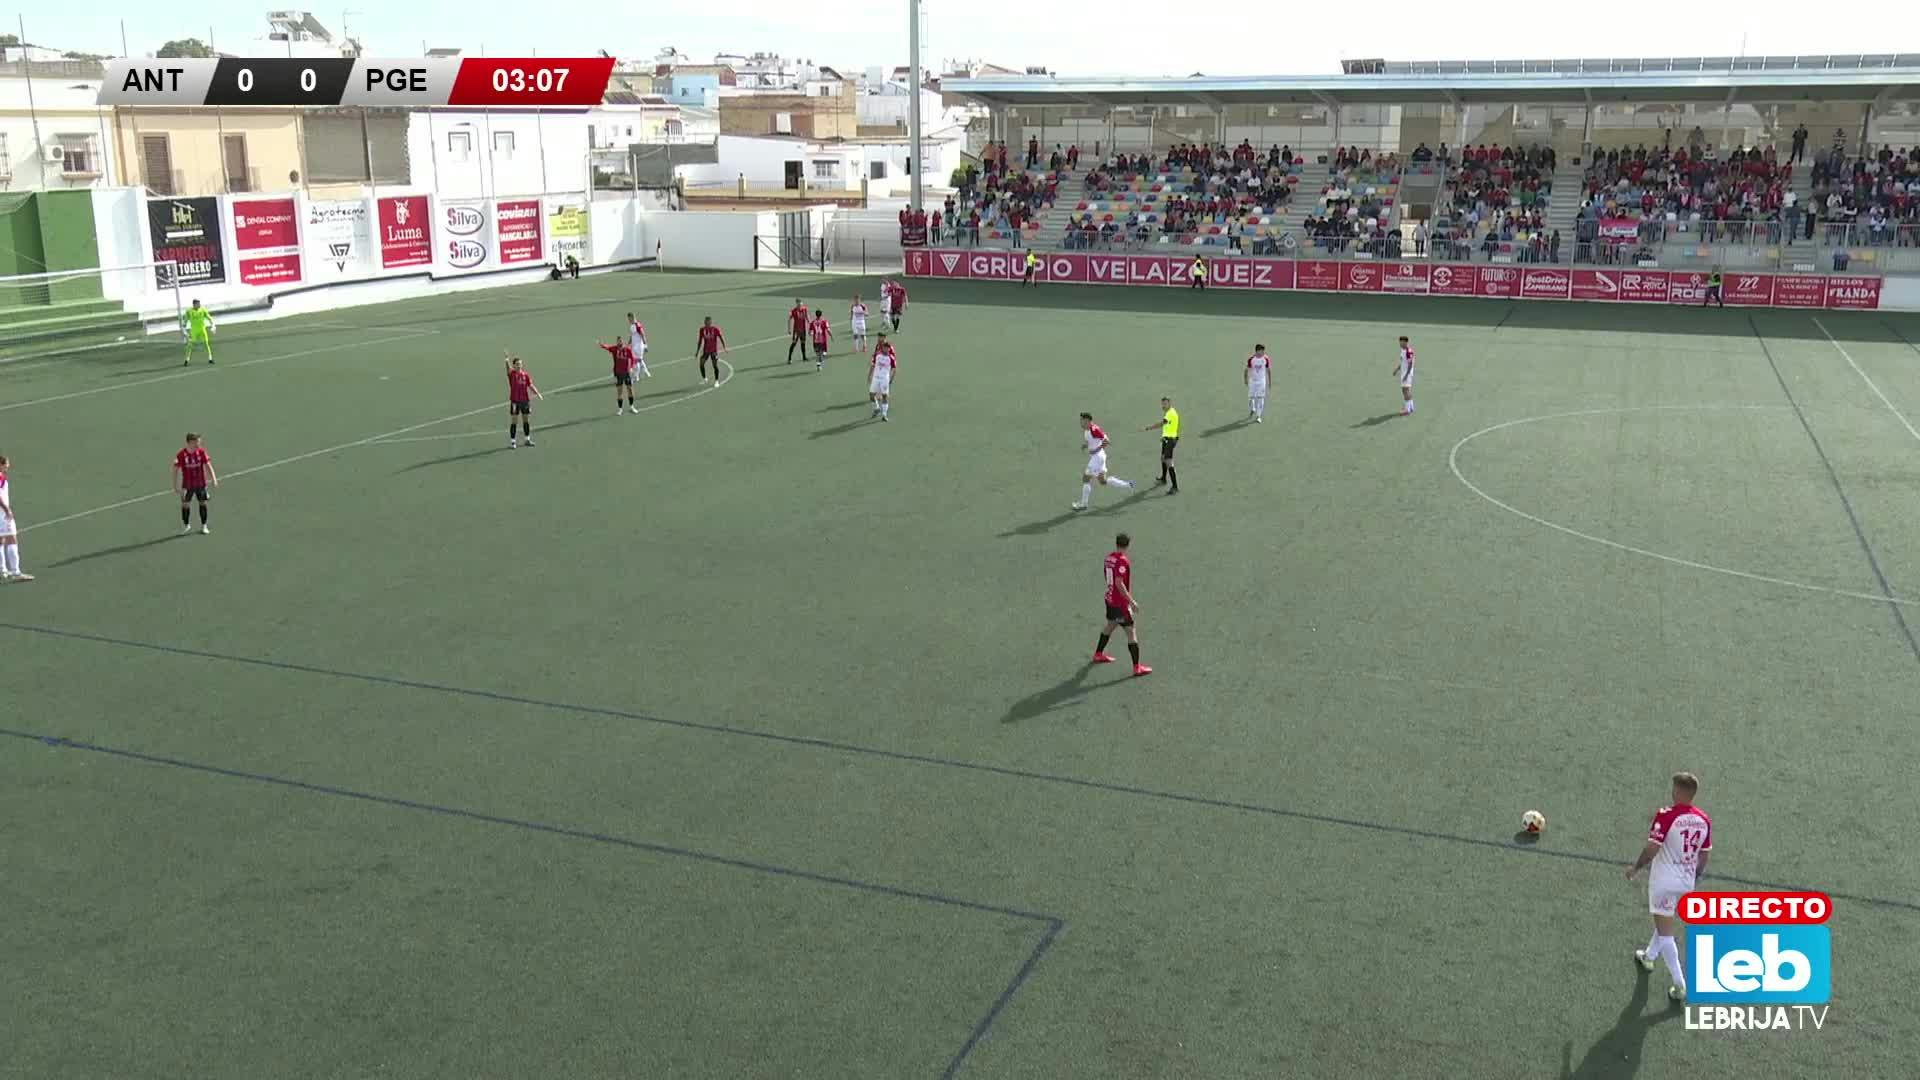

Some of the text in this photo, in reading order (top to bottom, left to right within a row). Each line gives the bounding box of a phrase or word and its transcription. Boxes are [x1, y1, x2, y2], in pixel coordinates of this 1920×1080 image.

[447, 207, 478, 226] Silva
[387, 225, 424, 242] Luma
[449, 240, 480, 259] Silva
[178, 260, 212, 275] TORERO
[971, 256, 1073, 277] GRUPO
[1091, 261, 1272, 284] VELAZQUEZ
[1680, 829, 1701, 853] 14
